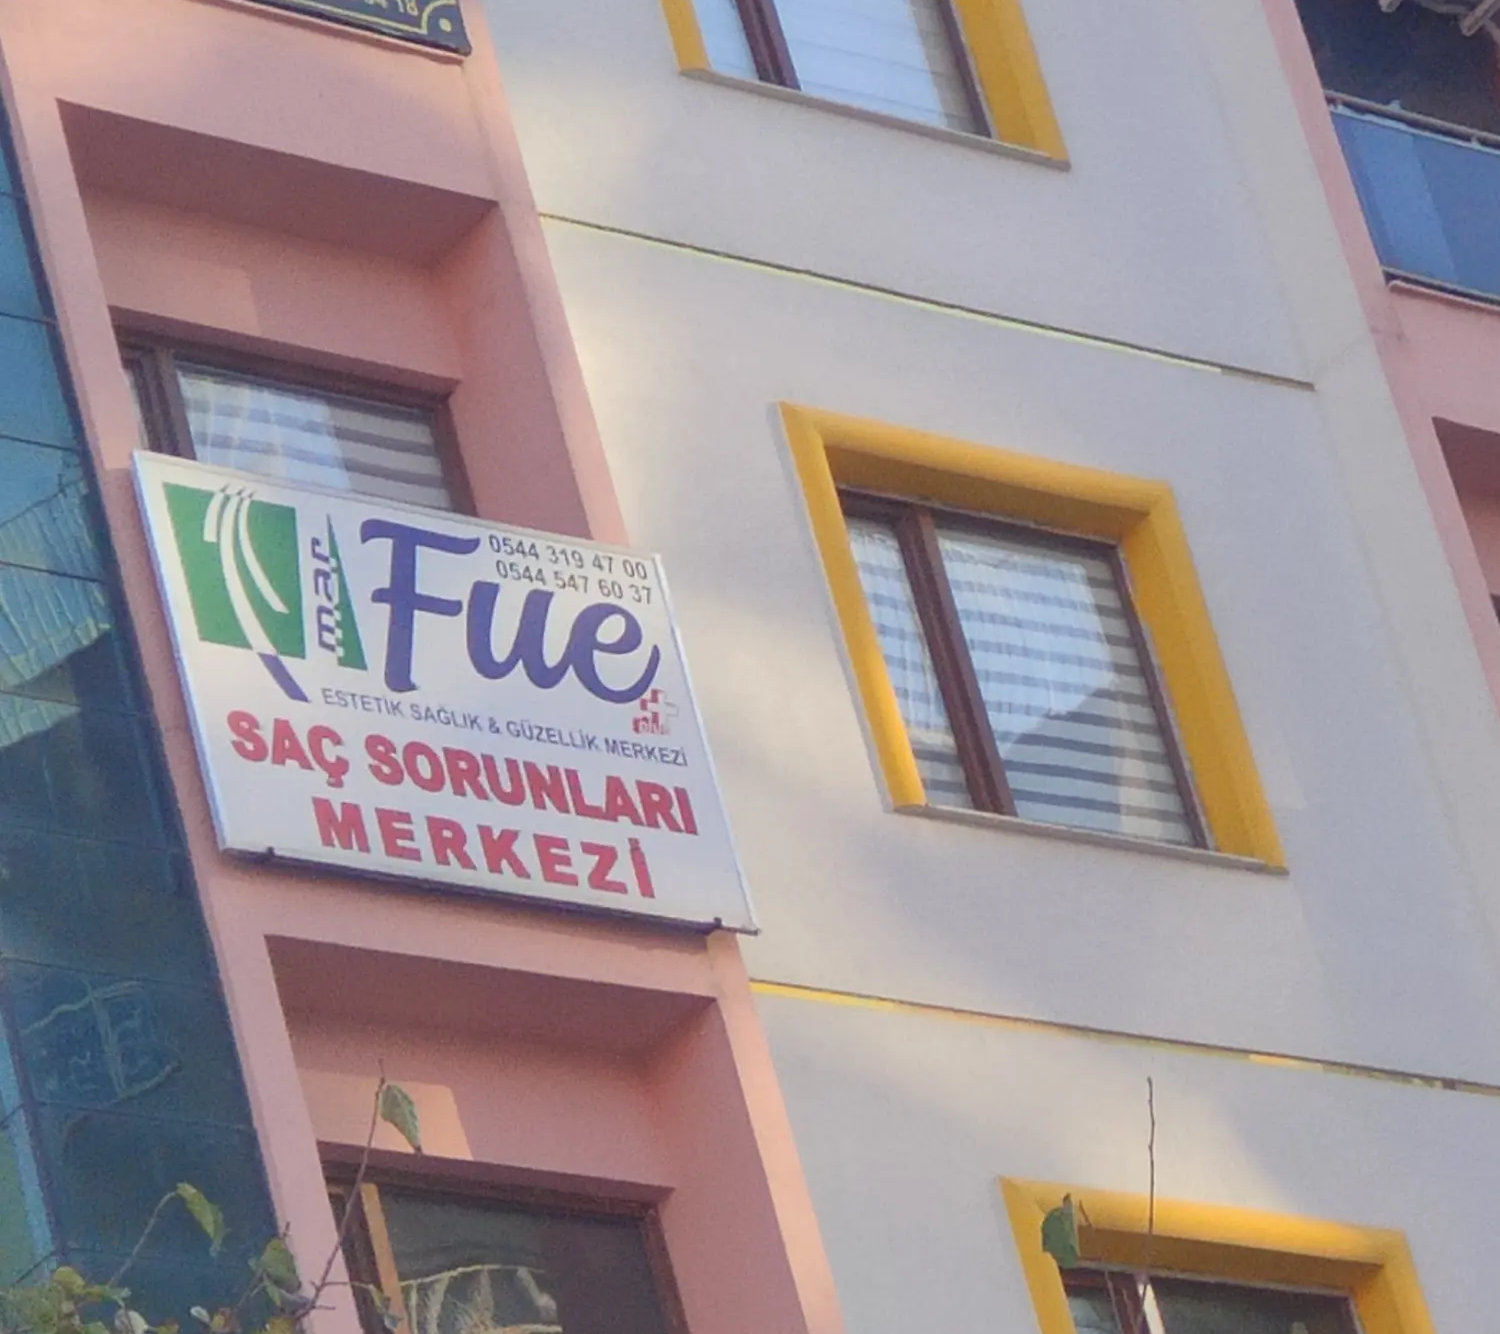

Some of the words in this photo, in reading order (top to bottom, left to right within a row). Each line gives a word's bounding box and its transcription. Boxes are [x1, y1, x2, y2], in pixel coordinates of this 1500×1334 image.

[489, 535, 540, 560] 0544
[546, 546, 584, 568] 319
[592, 555, 613, 574] 47
[623, 560, 647, 579] 00
[496, 560, 547, 586] 0544
[554, 571, 588, 594] 547
[599, 579, 623, 599] 60
[628, 585, 652, 604] 37
[360, 518, 661, 703] Fue
[227, 710, 350, 788] SAÇ
[365, 734, 699, 835] SORUNLARI
[322, 688, 404, 718] ESTETİK
[410, 702, 482, 732] SAĞLIK
[489, 718, 501, 735] &
[507, 719, 599, 752] GÜZELLİK
[604, 738, 688, 767] MERKEZİ
[313, 796, 656, 899] MERKEZİ
